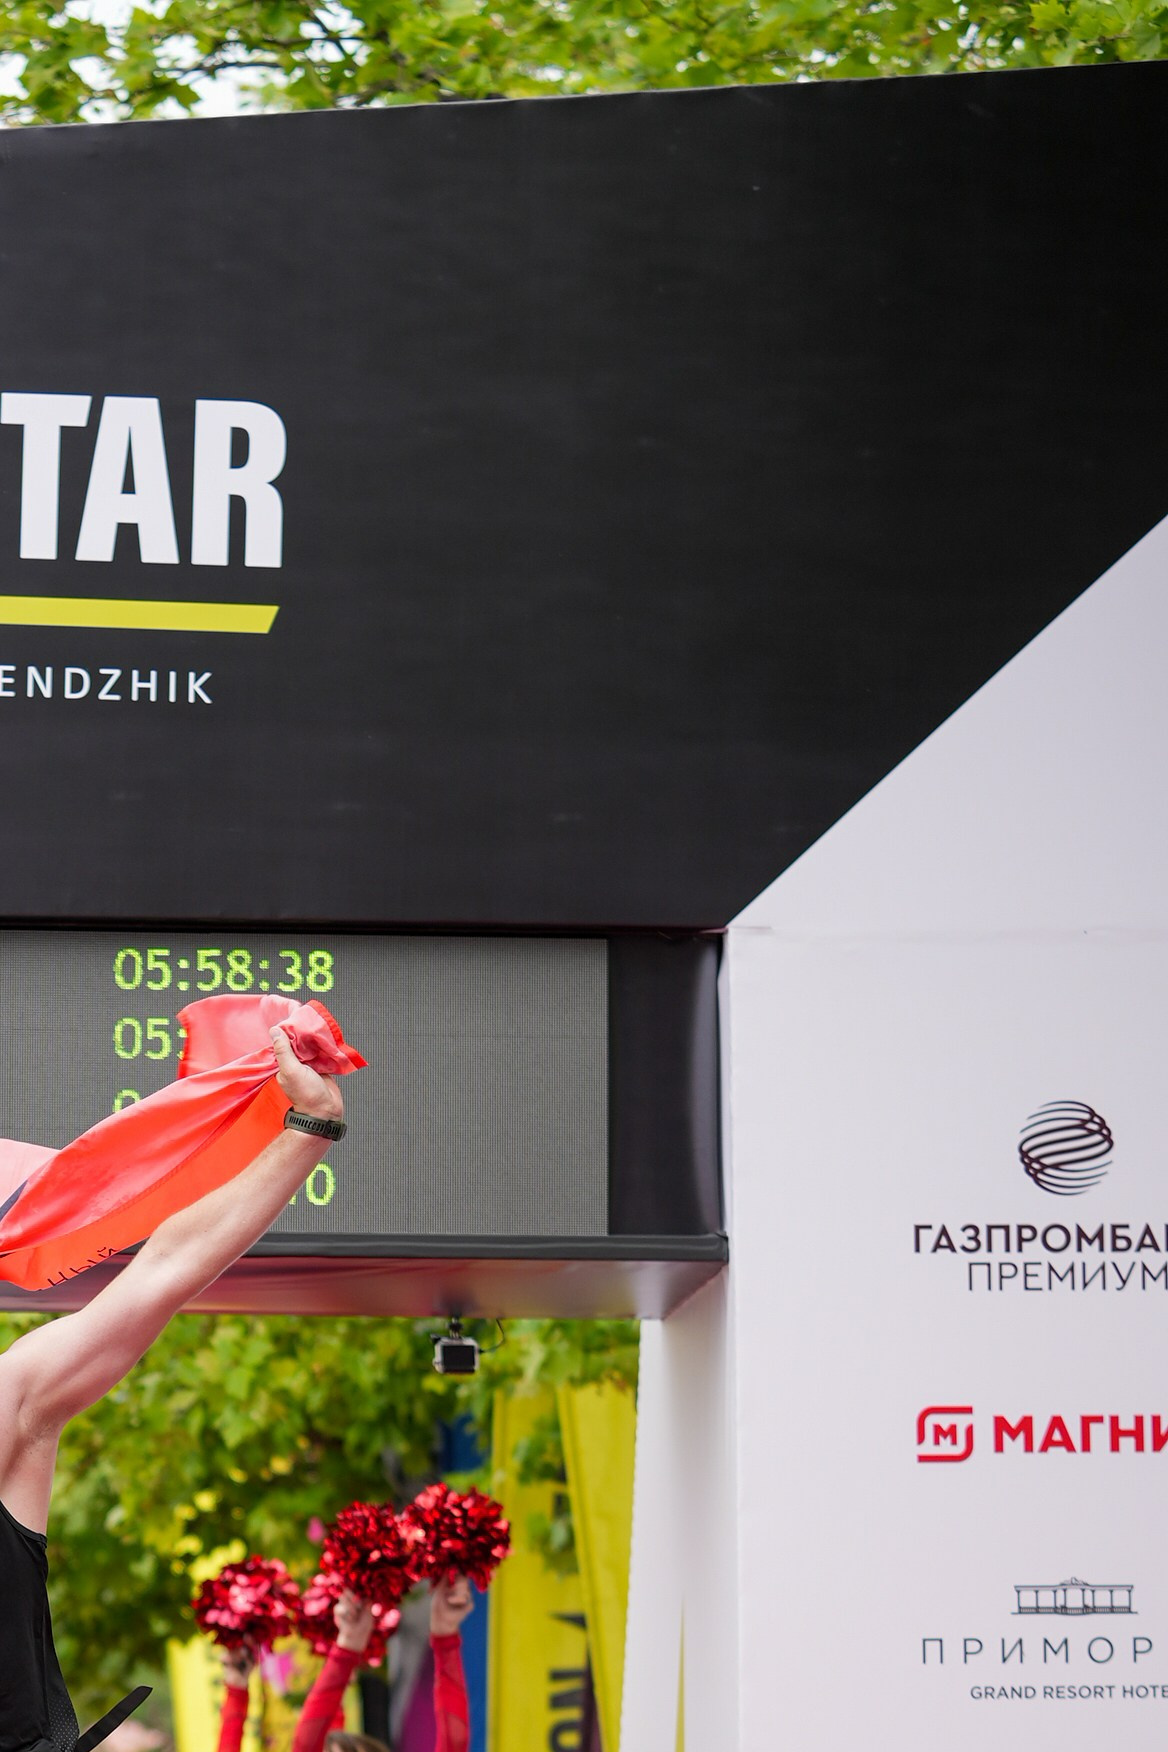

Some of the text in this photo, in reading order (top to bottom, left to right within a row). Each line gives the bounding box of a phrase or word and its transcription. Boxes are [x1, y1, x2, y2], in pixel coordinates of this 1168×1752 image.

[113, 946, 335, 993] 05:58:38
[913, 1223, 1168, 1254] ГАЗПРОМБА
[968, 1261, 1168, 1292] ПРЕМИУМ
[921, 1636, 1153, 1665] ПРИМОР
[970, 1685, 1168, 1700] GRAND RESORT HOTE
